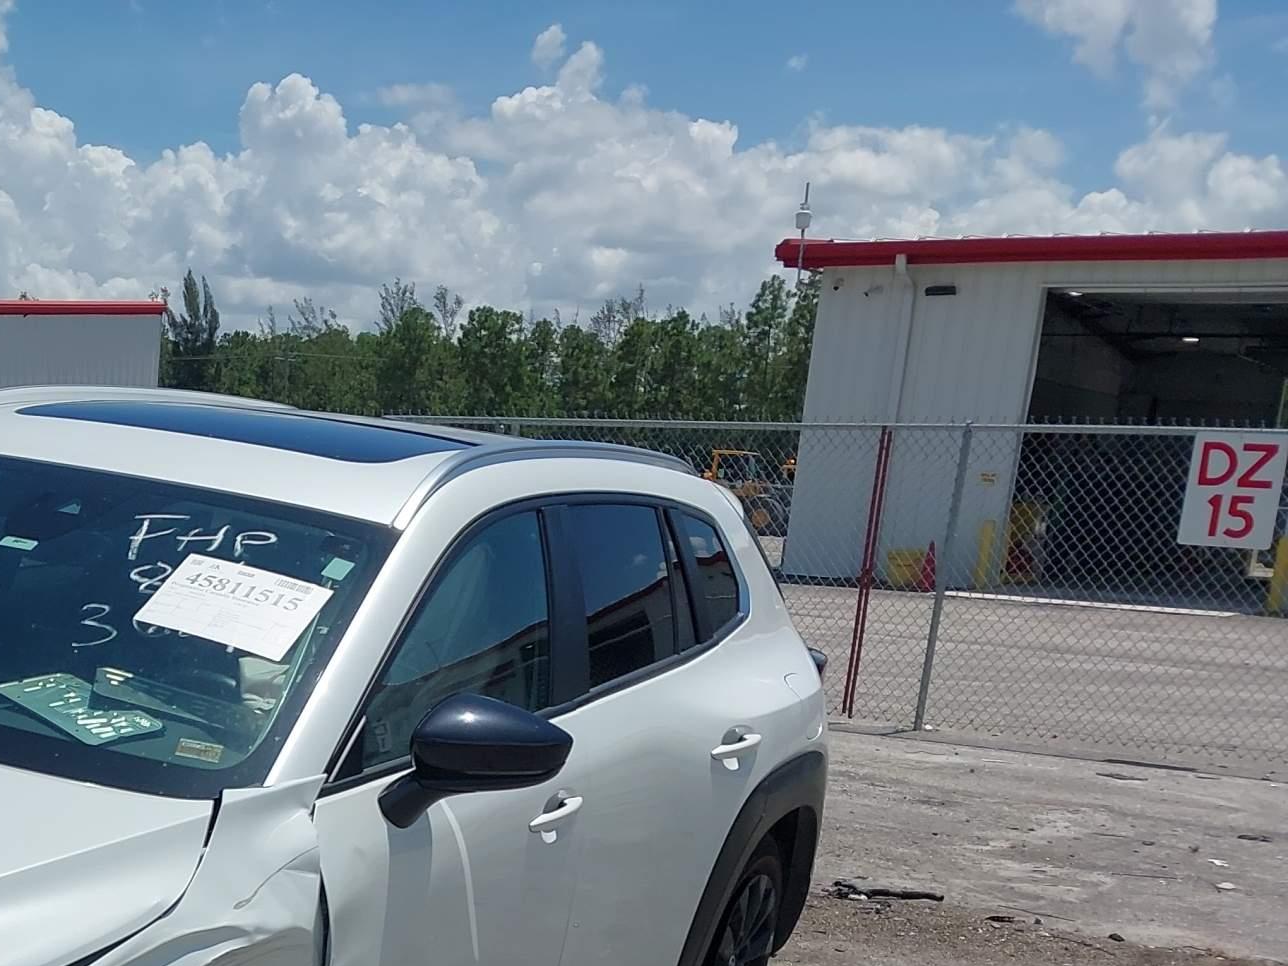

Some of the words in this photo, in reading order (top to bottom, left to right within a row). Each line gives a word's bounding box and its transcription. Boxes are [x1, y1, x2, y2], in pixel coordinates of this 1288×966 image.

[1197, 441, 1280, 489] DZ
[128, 514, 278, 560] FHP
[1207, 494, 1255, 539] 15
[185, 572, 304, 611] 45811515
